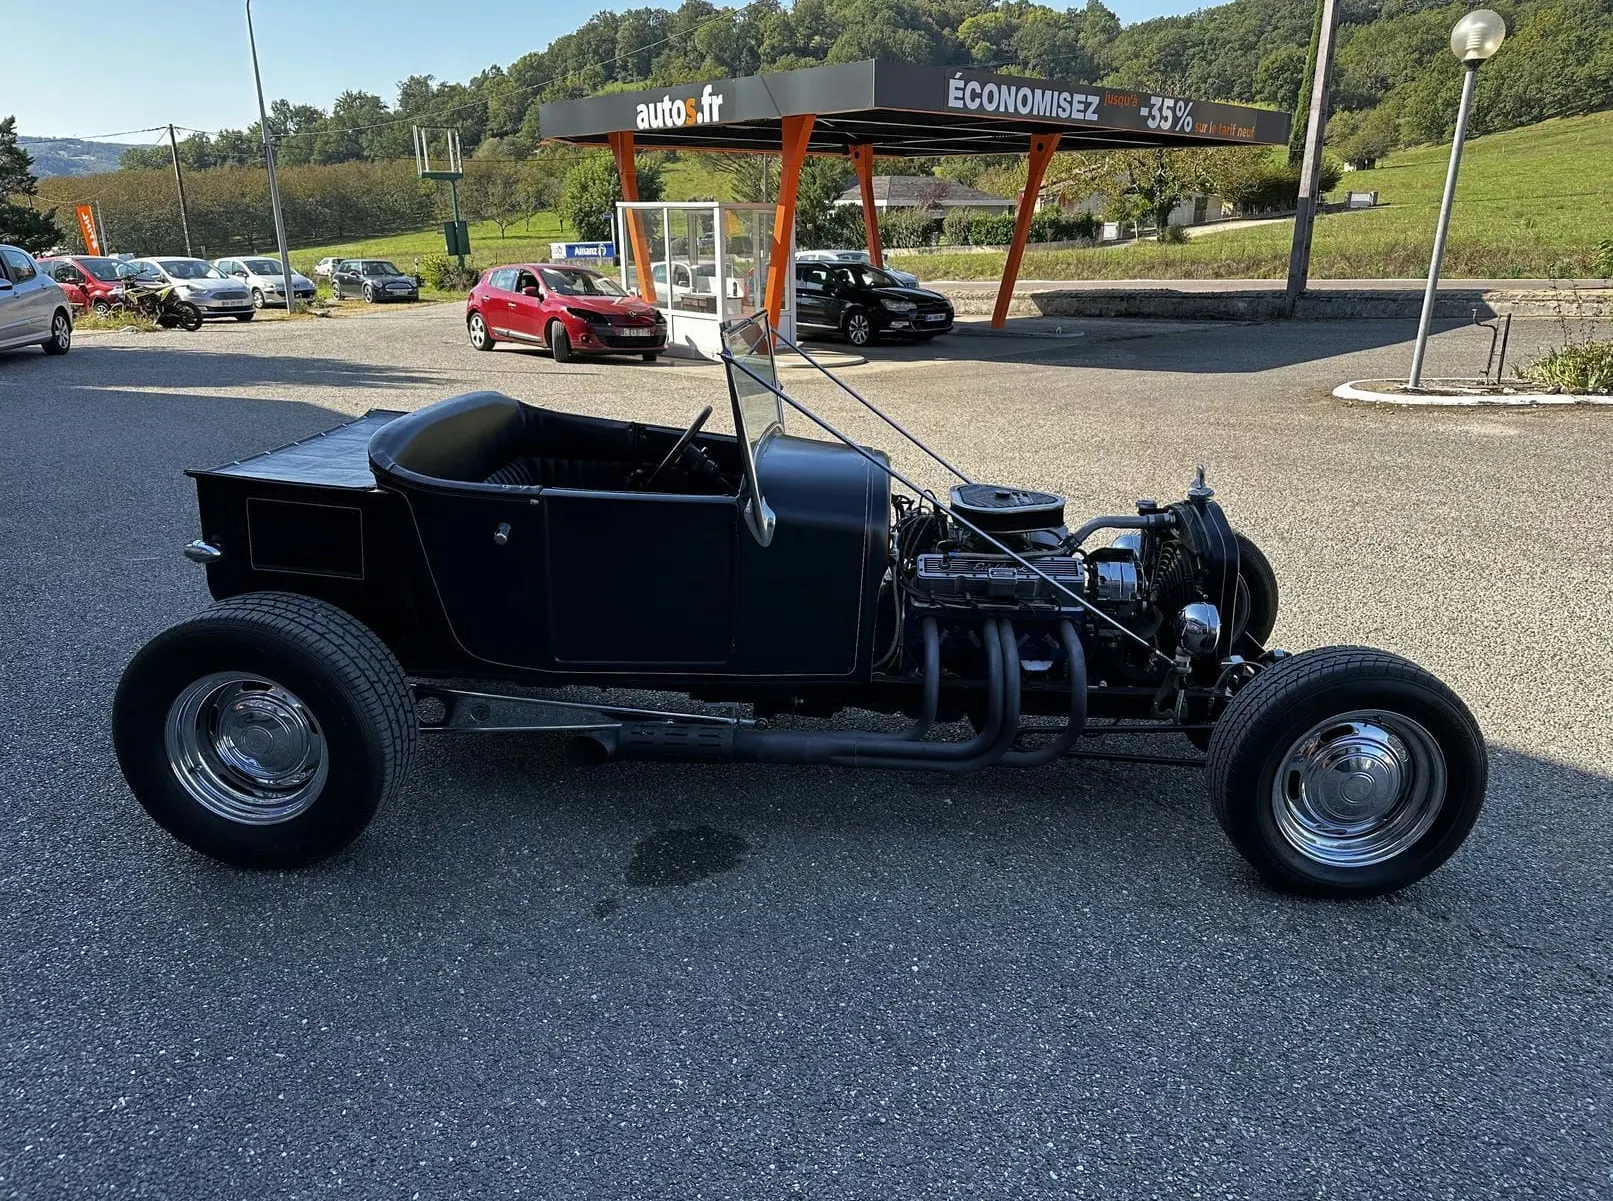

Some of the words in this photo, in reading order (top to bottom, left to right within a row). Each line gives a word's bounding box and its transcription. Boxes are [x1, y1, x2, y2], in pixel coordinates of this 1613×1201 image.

[636, 84, 723, 130] autos.fr
[948, 72, 1100, 121] ÉCONOMISEZ
[1104, 90, 1138, 108] jusqu'à
[1139, 96, 1193, 133] -35%
[1194, 121, 1208, 133] sur
[1208, 120, 1217, 134] le
[1218, 122, 1237, 137] tarif
[1237, 125, 1255, 139] neuf
[574, 246, 598, 256] Allianz
